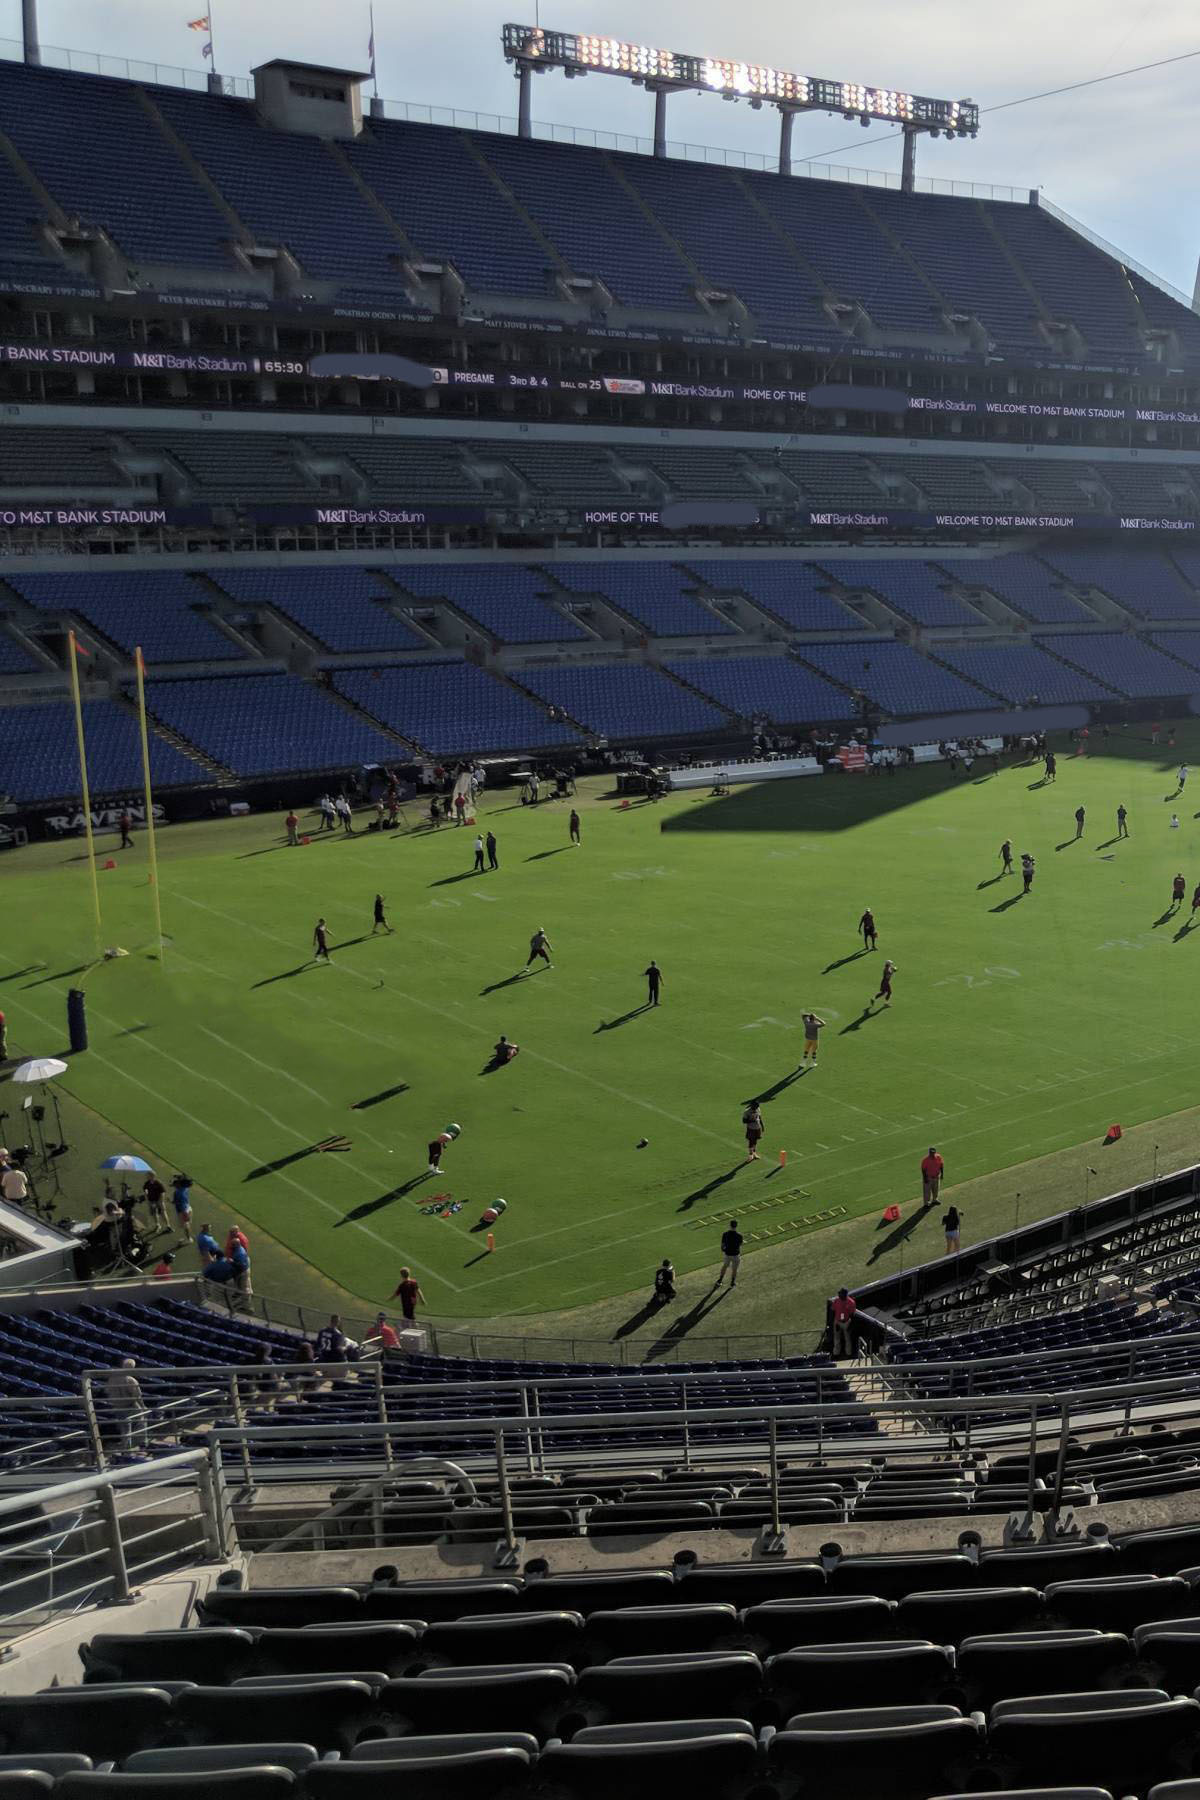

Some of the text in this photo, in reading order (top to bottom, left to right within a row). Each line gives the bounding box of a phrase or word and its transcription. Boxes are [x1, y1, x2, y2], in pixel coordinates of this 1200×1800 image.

[8, 347, 50, 361] BANK
[53, 350, 116, 364] STADIUM
[133, 352, 248, 372] M&T Bank Stadium
[264, 361, 303, 373] 65:30
[454, 371, 495, 384] PREGAME
[529, 376, 538, 387] &
[541, 377, 549, 387] 4
[589, 379, 601, 390] 25
[651, 382, 675, 395] M&T
[675, 384, 698, 396] Bank
[699, 385, 735, 399] Stadium
[743, 388, 807, 402] HOME OF THE
[926, 399, 945, 410] Bank
[945, 400, 977, 412] Stadium
[986, 403, 1125, 419] WELCOME TO M&T BANK STADIUM
[1136, 410, 1158, 421] M&T
[1158, 410, 1176, 422] Bank
[20, 511, 53, 524] M&T
[57, 511, 99, 524] BANK
[102, 510, 166, 523] STADIUM
[317, 510, 425, 523] M&T Bank Stadium
[585, 511, 659, 523] HOME OF THE
[810, 512, 888, 526] M&T Bank Stadium
[935, 515, 1074, 527] WELCOME TO M&T BANK STADIUM
[1120, 518, 1195, 530] M&T Bank Stadium
[45, 804, 166, 831] RAVENS
